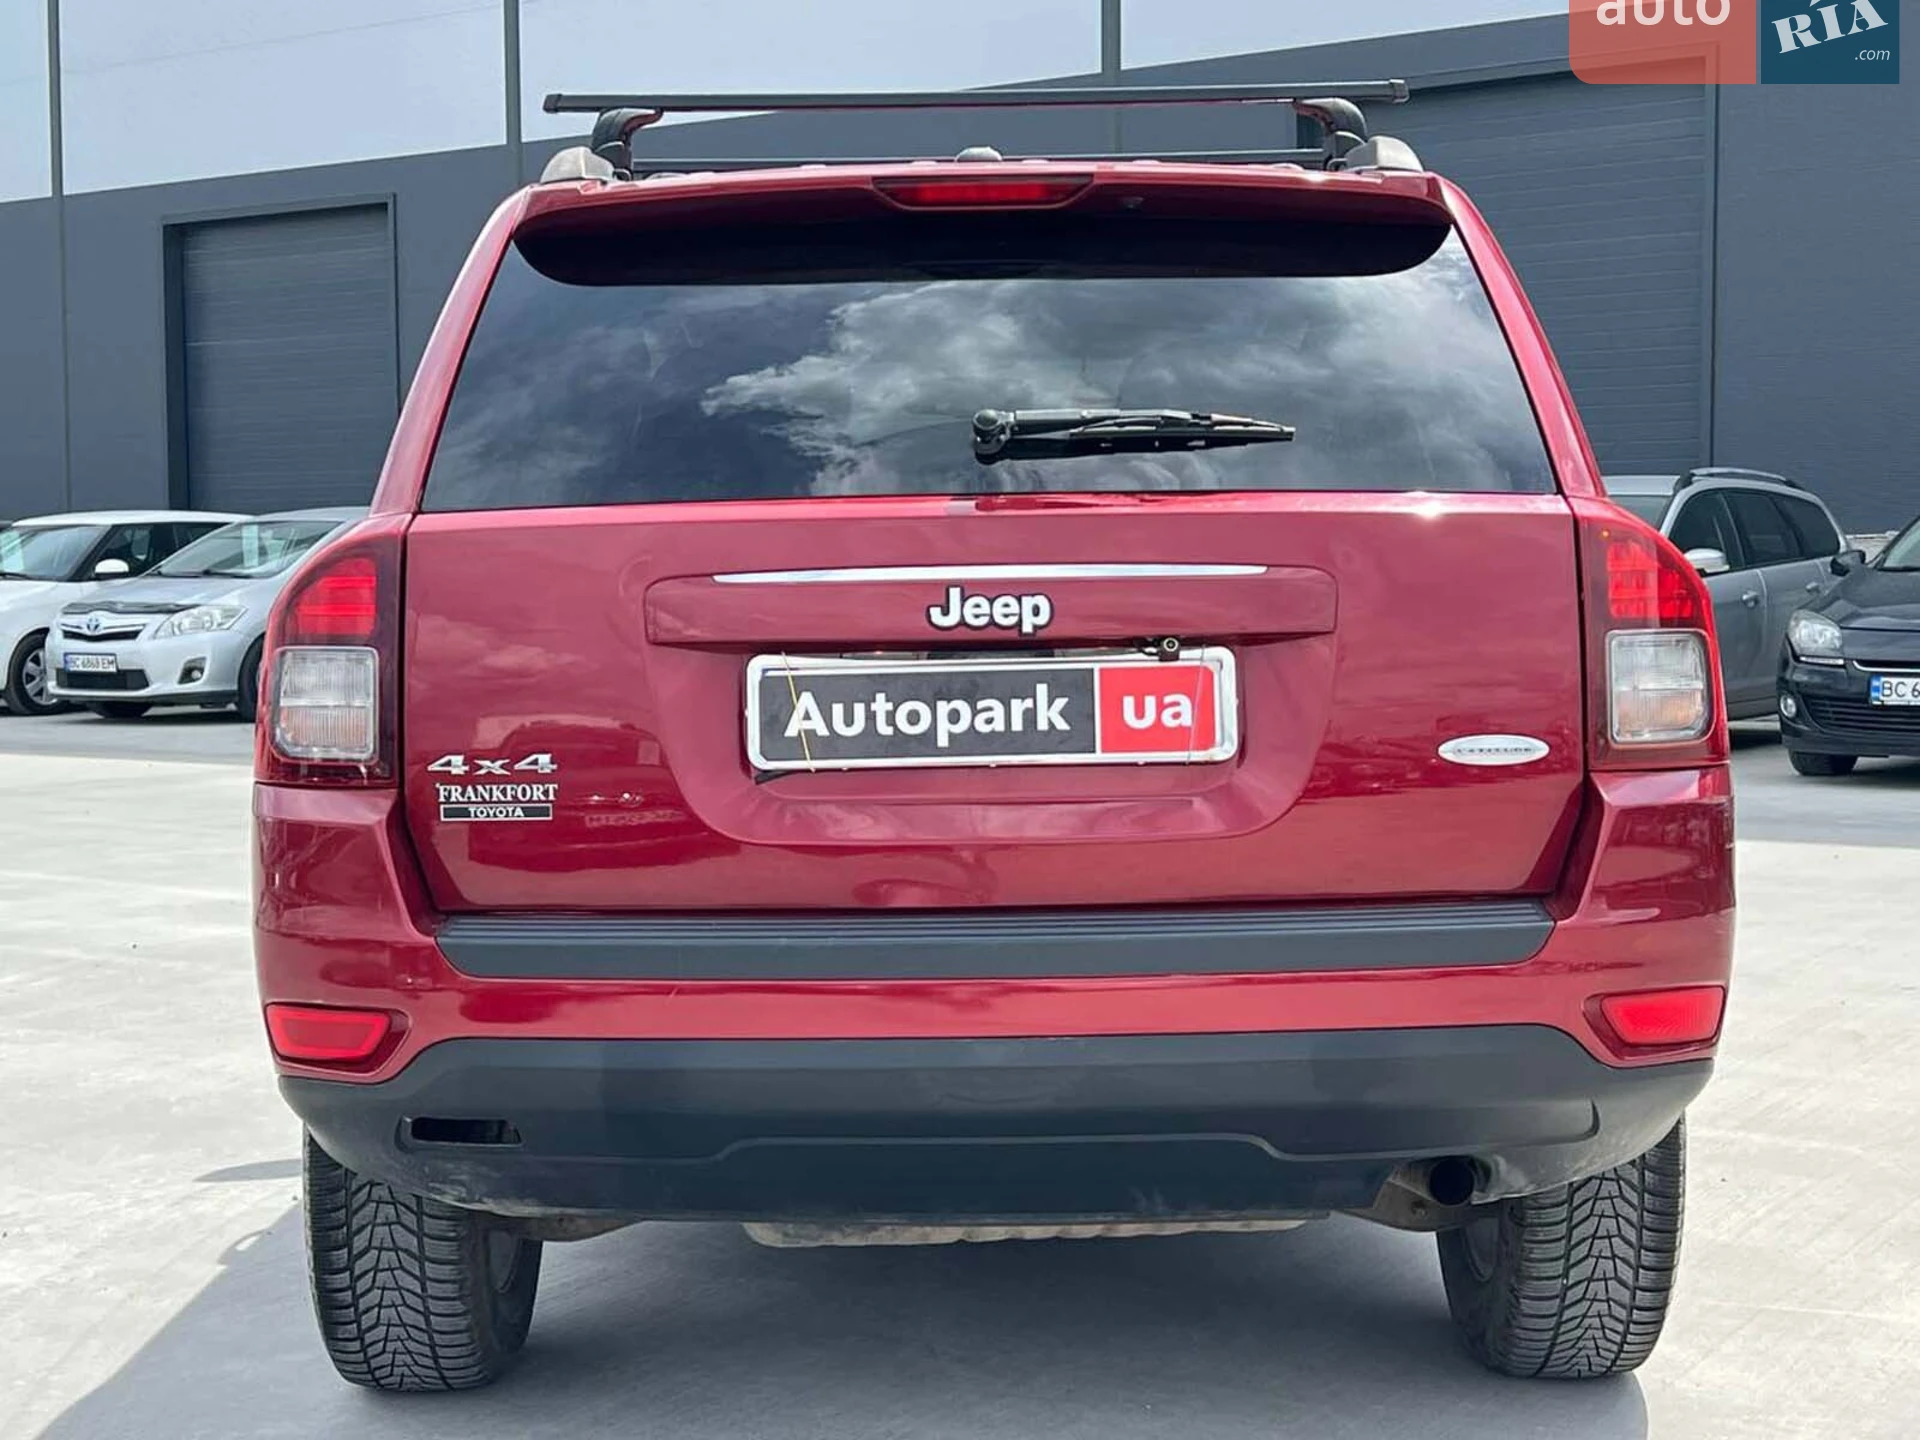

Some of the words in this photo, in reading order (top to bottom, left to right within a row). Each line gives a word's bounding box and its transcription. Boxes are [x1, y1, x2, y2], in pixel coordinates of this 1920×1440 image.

[928, 585, 1053, 635] Jeep
[1881, 680, 1907, 698] BC
[784, 683, 1071, 748] Autopark
[1122, 692, 1194, 729] ua
[427, 753, 558, 775] 4x4
[438, 784, 558, 802] FRANKFORT
[468, 807, 525, 818] TOYOTA
